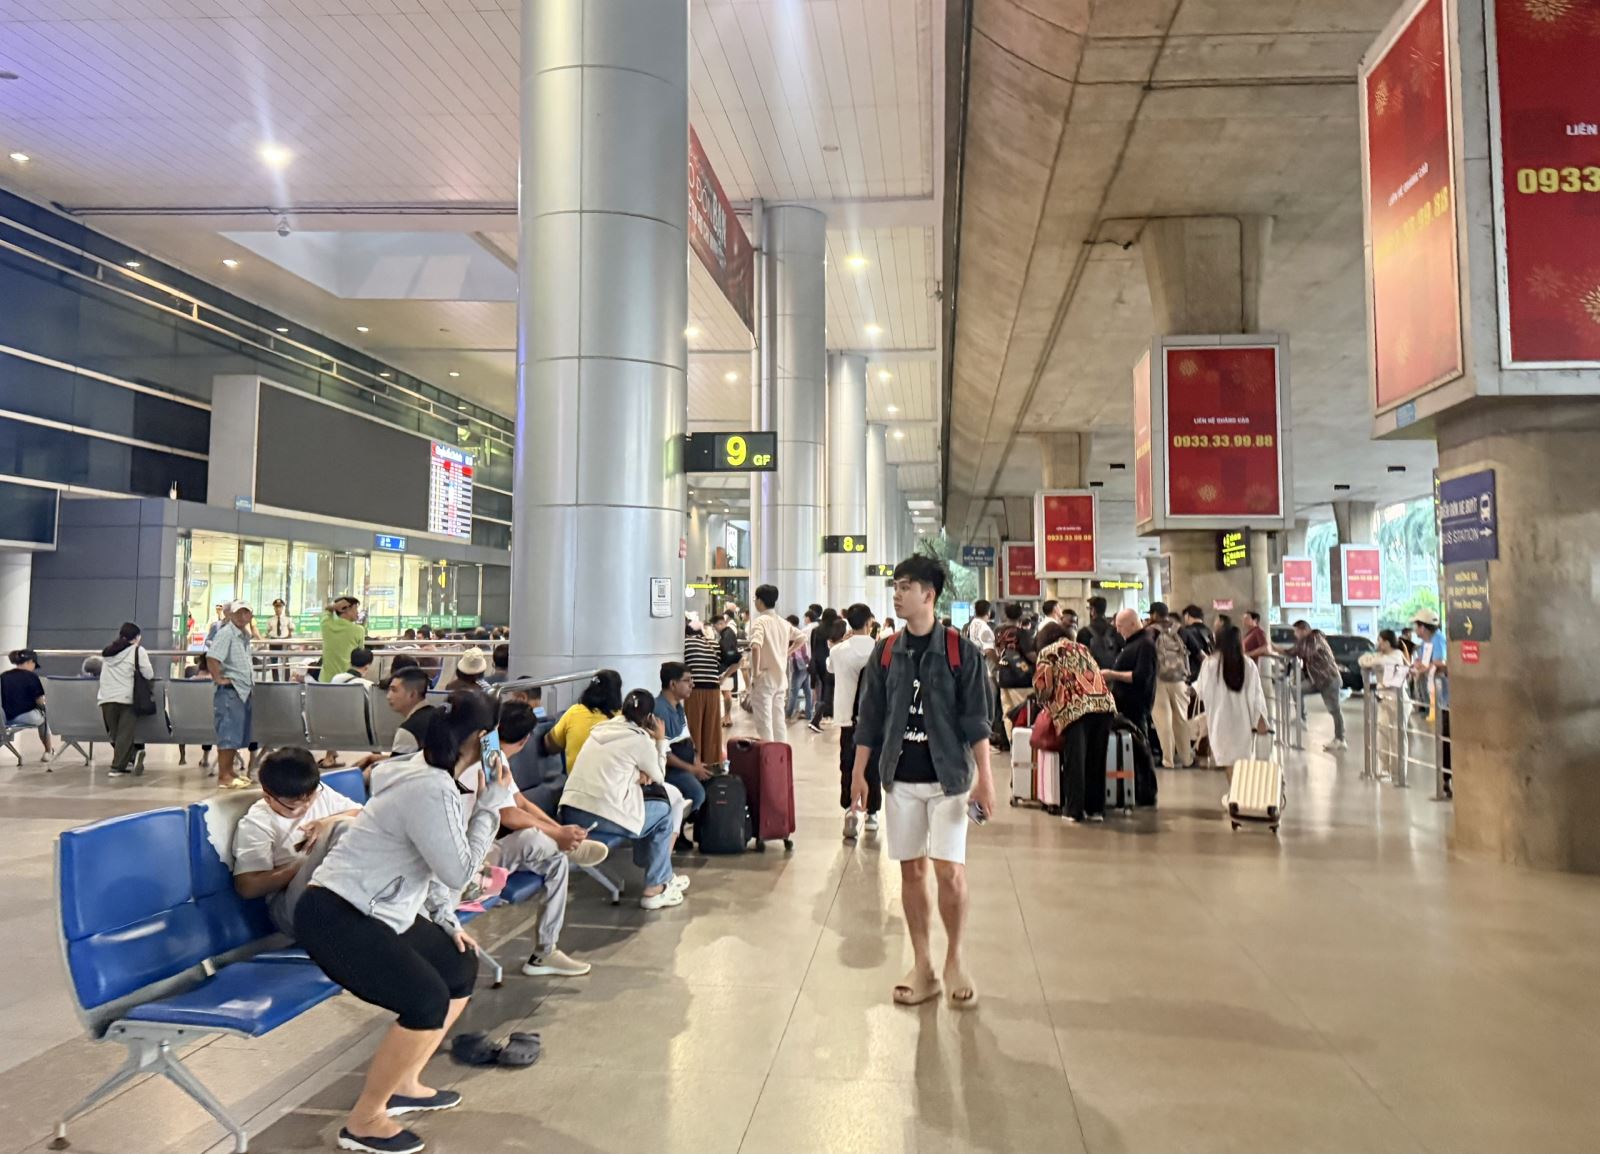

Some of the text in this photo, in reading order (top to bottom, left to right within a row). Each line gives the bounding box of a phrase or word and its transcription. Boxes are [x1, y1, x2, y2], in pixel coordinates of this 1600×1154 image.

[1566, 122, 1598, 136] LIÊN
[1517, 166, 1600, 194] 0933
[1173, 434, 1273, 448] 0933.33.99.88
[726, 436, 771, 466] 9 GF
[1453, 527, 1479, 544] STATION
[843, 536, 853, 552] 8
[878, 565, 886, 576] 7
